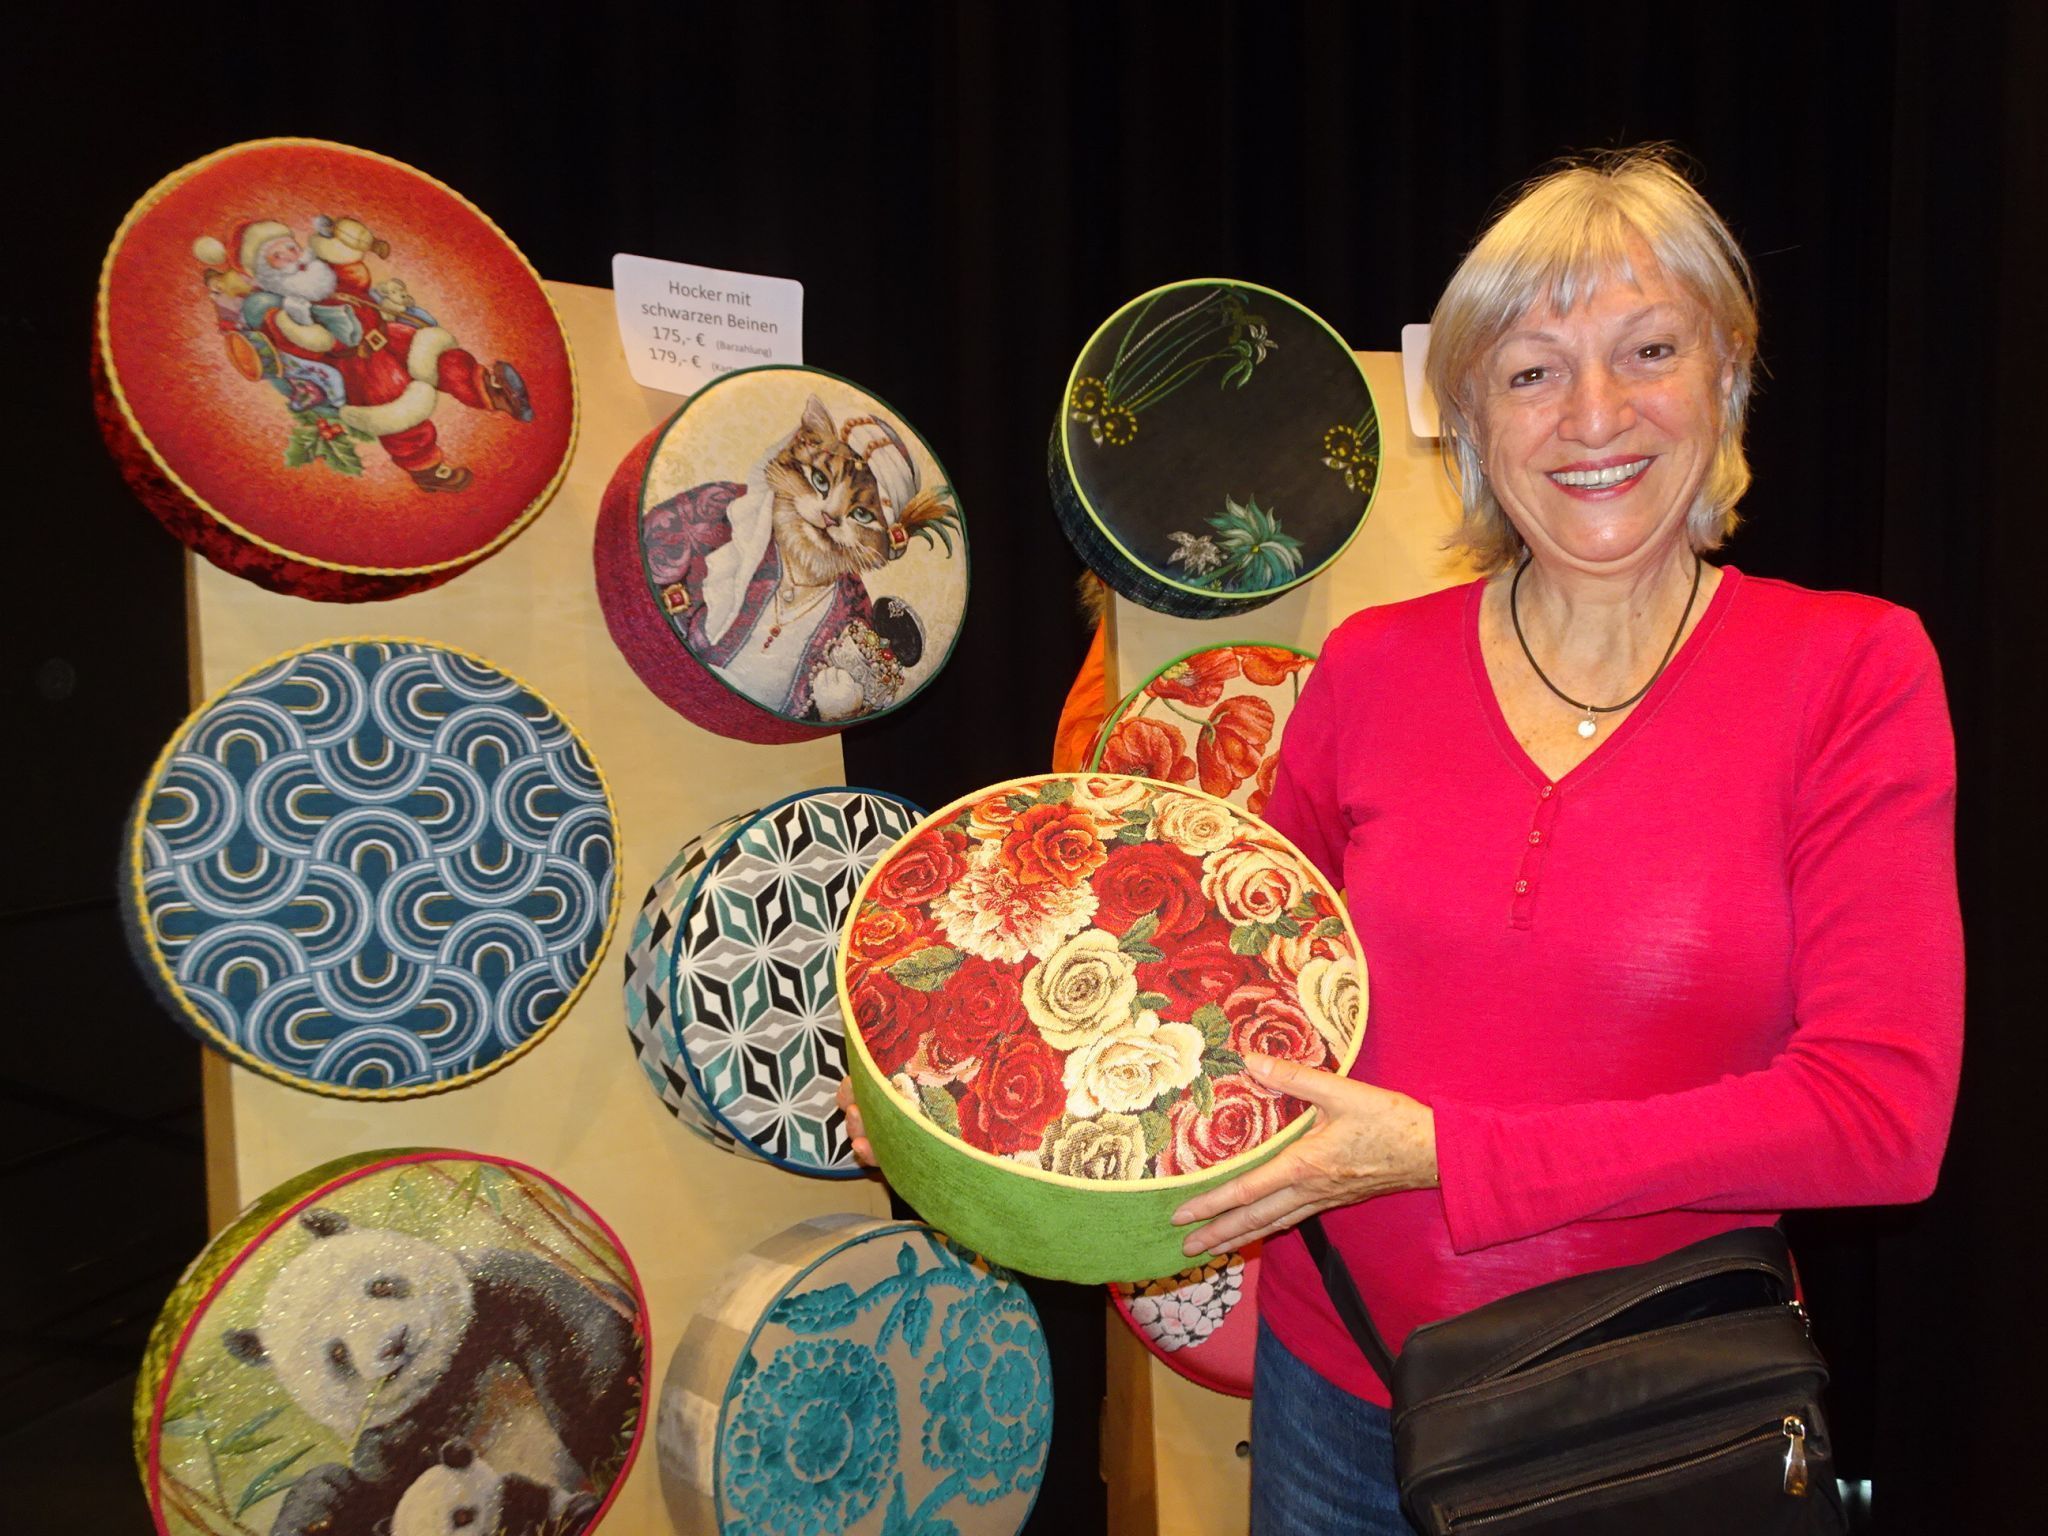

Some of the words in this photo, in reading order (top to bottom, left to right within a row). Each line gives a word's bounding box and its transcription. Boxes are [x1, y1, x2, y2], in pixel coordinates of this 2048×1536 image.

[668, 280, 722, 302] Hocker
[726, 291, 752, 306] mit
[641, 302, 723, 326] schwarzen
[727, 313, 778, 334] Beinen
[652, 326, 691, 346] 175,-
[696, 332, 705, 347] €
[716, 340, 773, 358] (Barzahlung)
[649, 347, 687, 367] 179,-
[691, 355, 701, 368] €
